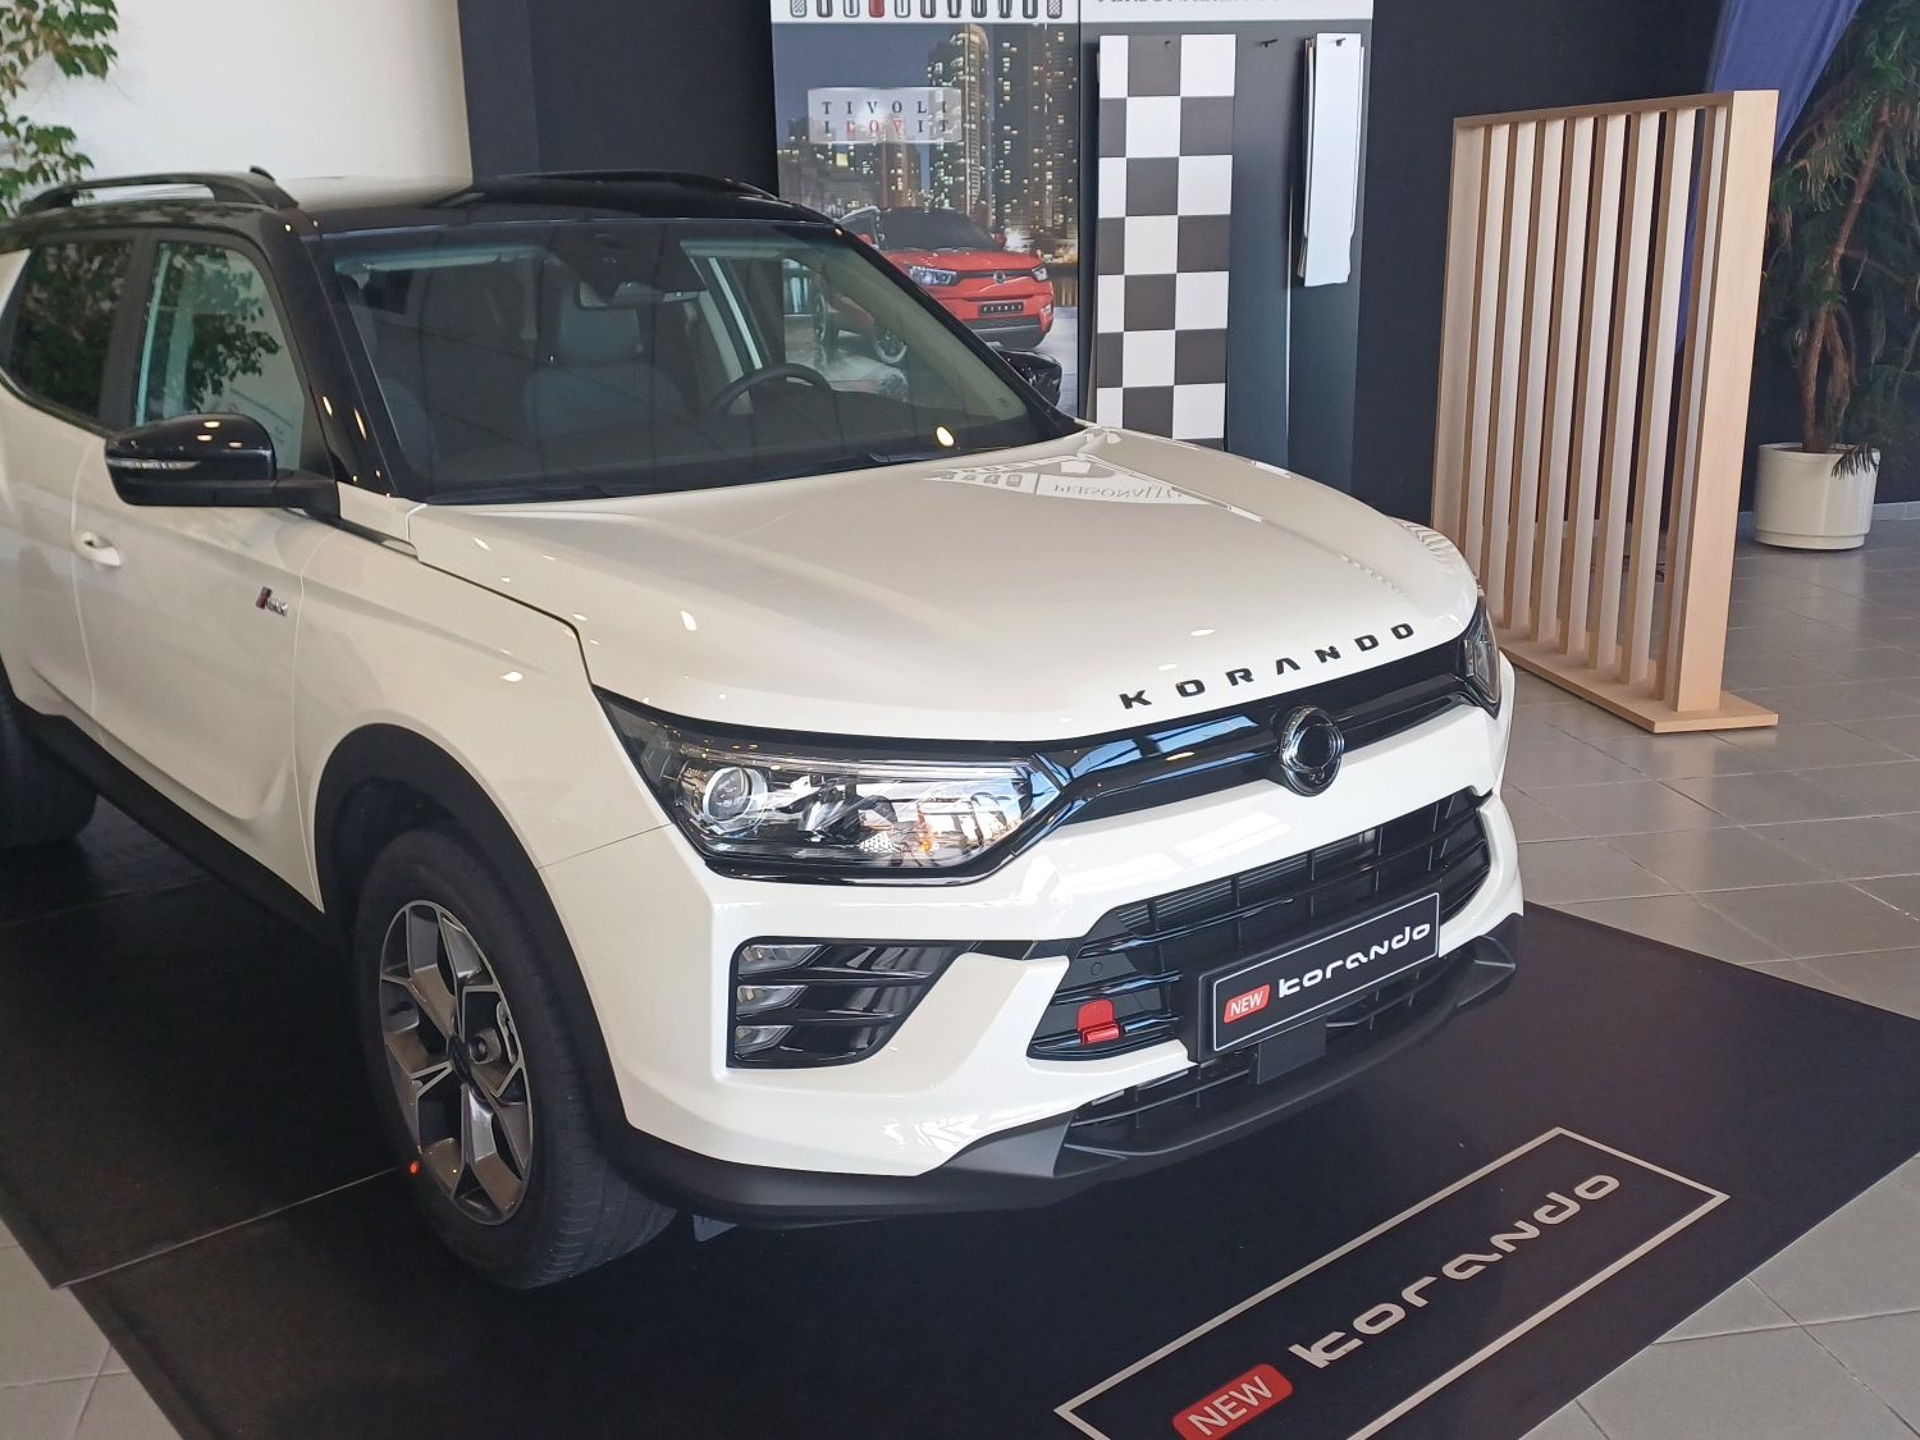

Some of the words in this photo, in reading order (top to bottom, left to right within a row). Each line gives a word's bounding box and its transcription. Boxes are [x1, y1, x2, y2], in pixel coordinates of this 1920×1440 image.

[822, 101, 947, 115] TIVOLI
[1119, 622, 1415, 710] KORANDO
[1230, 990, 1265, 1017] NEW
[1278, 920, 1432, 998] korando
[1187, 1373, 1273, 1437] NEW
[1288, 1173, 1621, 1369] korando
